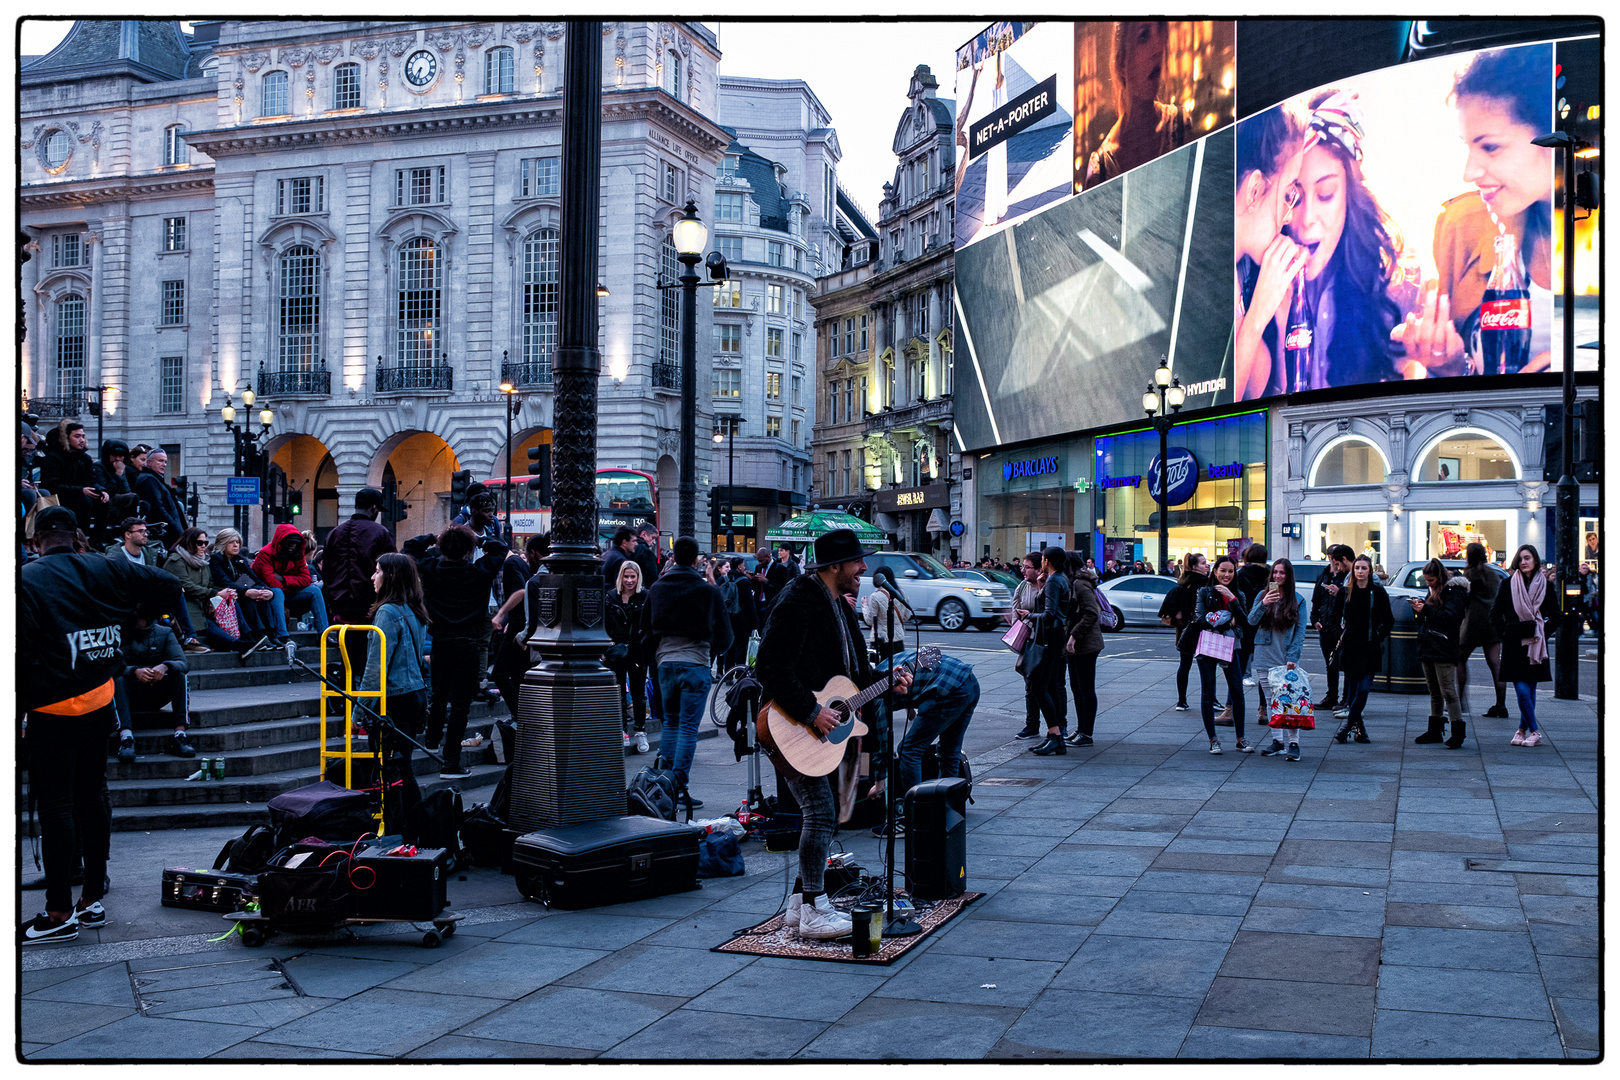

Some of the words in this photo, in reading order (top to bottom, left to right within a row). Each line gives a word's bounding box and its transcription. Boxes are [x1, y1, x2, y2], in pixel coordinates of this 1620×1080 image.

[976, 91, 1049, 146] NET-A-PORTER
[649, 129, 670, 148] ALLIANCE
[672, 142, 682, 156] LIFE
[684, 150, 699, 165] OFFICE
[1186, 377, 1226, 397] HYUNDAI
[1013, 456, 1057, 478] BARCLAYS
[1208, 461, 1242, 478] beauty
[1100, 475, 1140, 491] pharmacy
[896, 492, 913, 506] JEWEL
[912, 491, 925, 504] BAR
[599, 518, 626, 526] Waterloo
[66, 624, 122, 670] YEEZUS
[86, 646, 115, 661] TOUR
